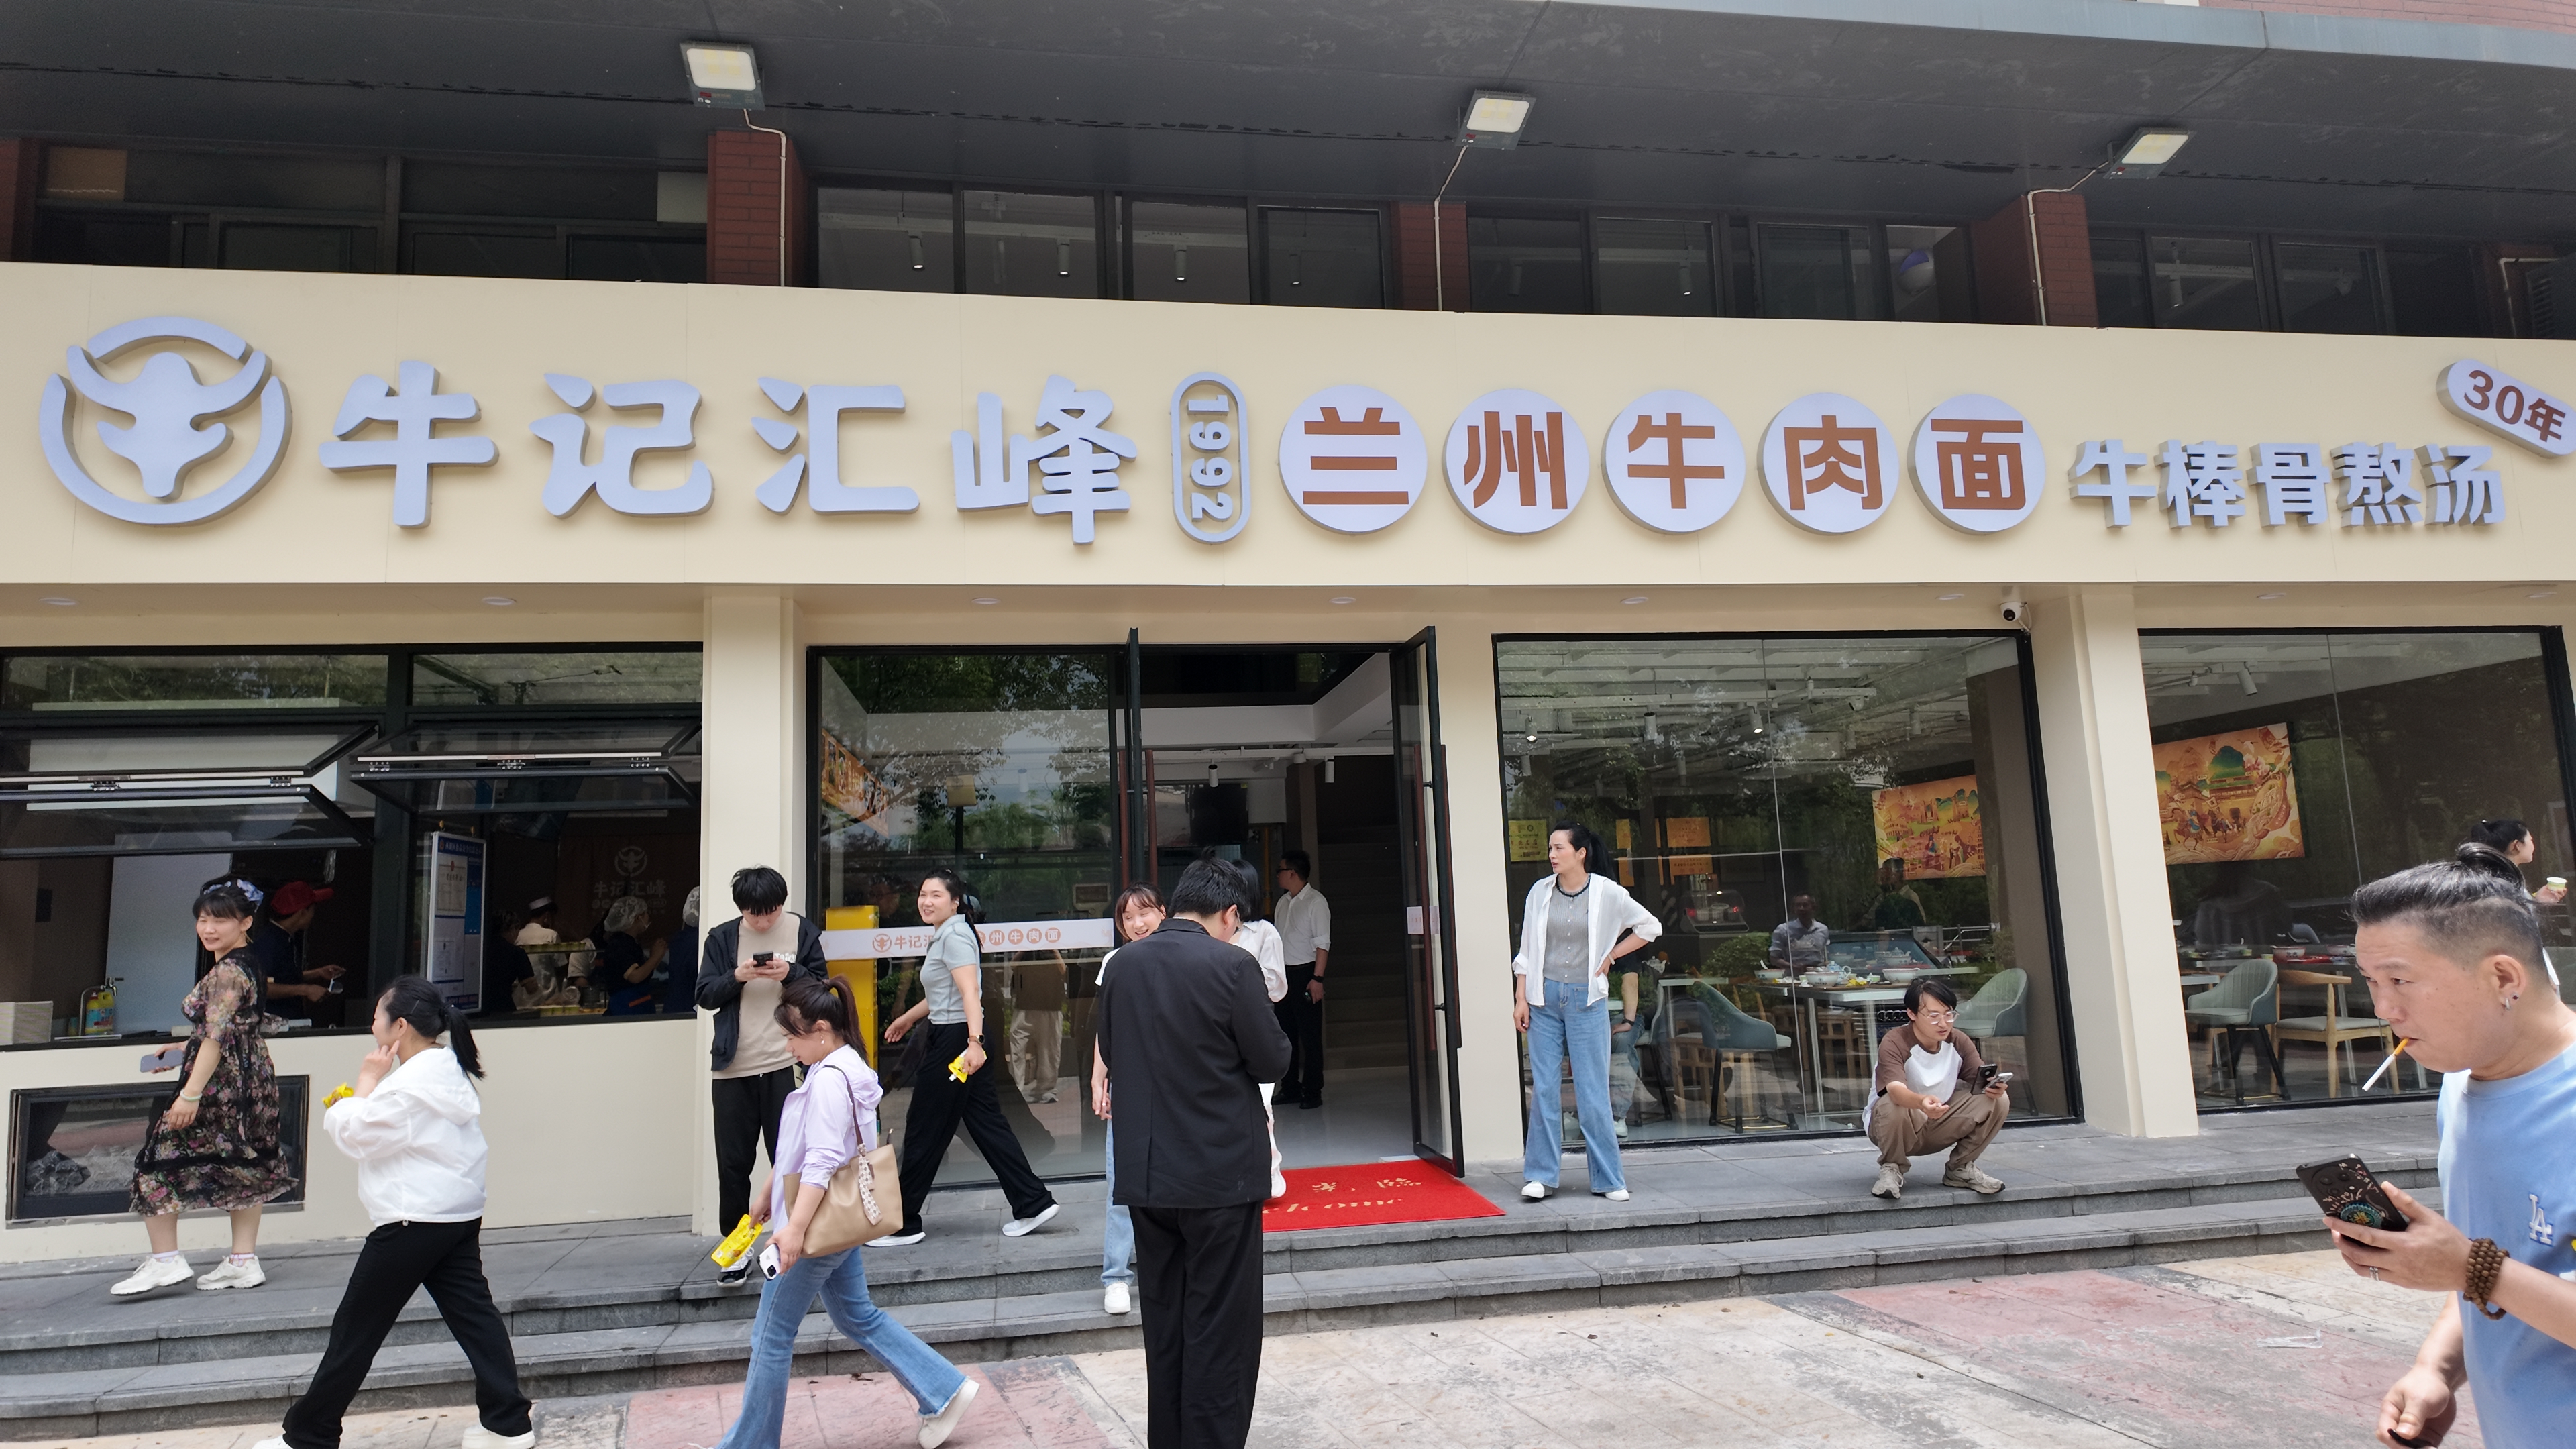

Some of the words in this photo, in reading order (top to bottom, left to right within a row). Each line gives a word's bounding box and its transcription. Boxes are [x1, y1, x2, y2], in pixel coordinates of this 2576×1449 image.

[2463, 370, 2566, 443] 30年
[319, 360, 1138, 545] 牛记汇峰
[1187, 394, 1234, 522] 1992
[1302, 407, 2025, 511] 兰州牛肉面
[2068, 439, 2507, 529] 牛棒骨熬汤
[593, 879, 666, 898] 牛记汇峰
[2529, 1193, 2553, 1246] LA
